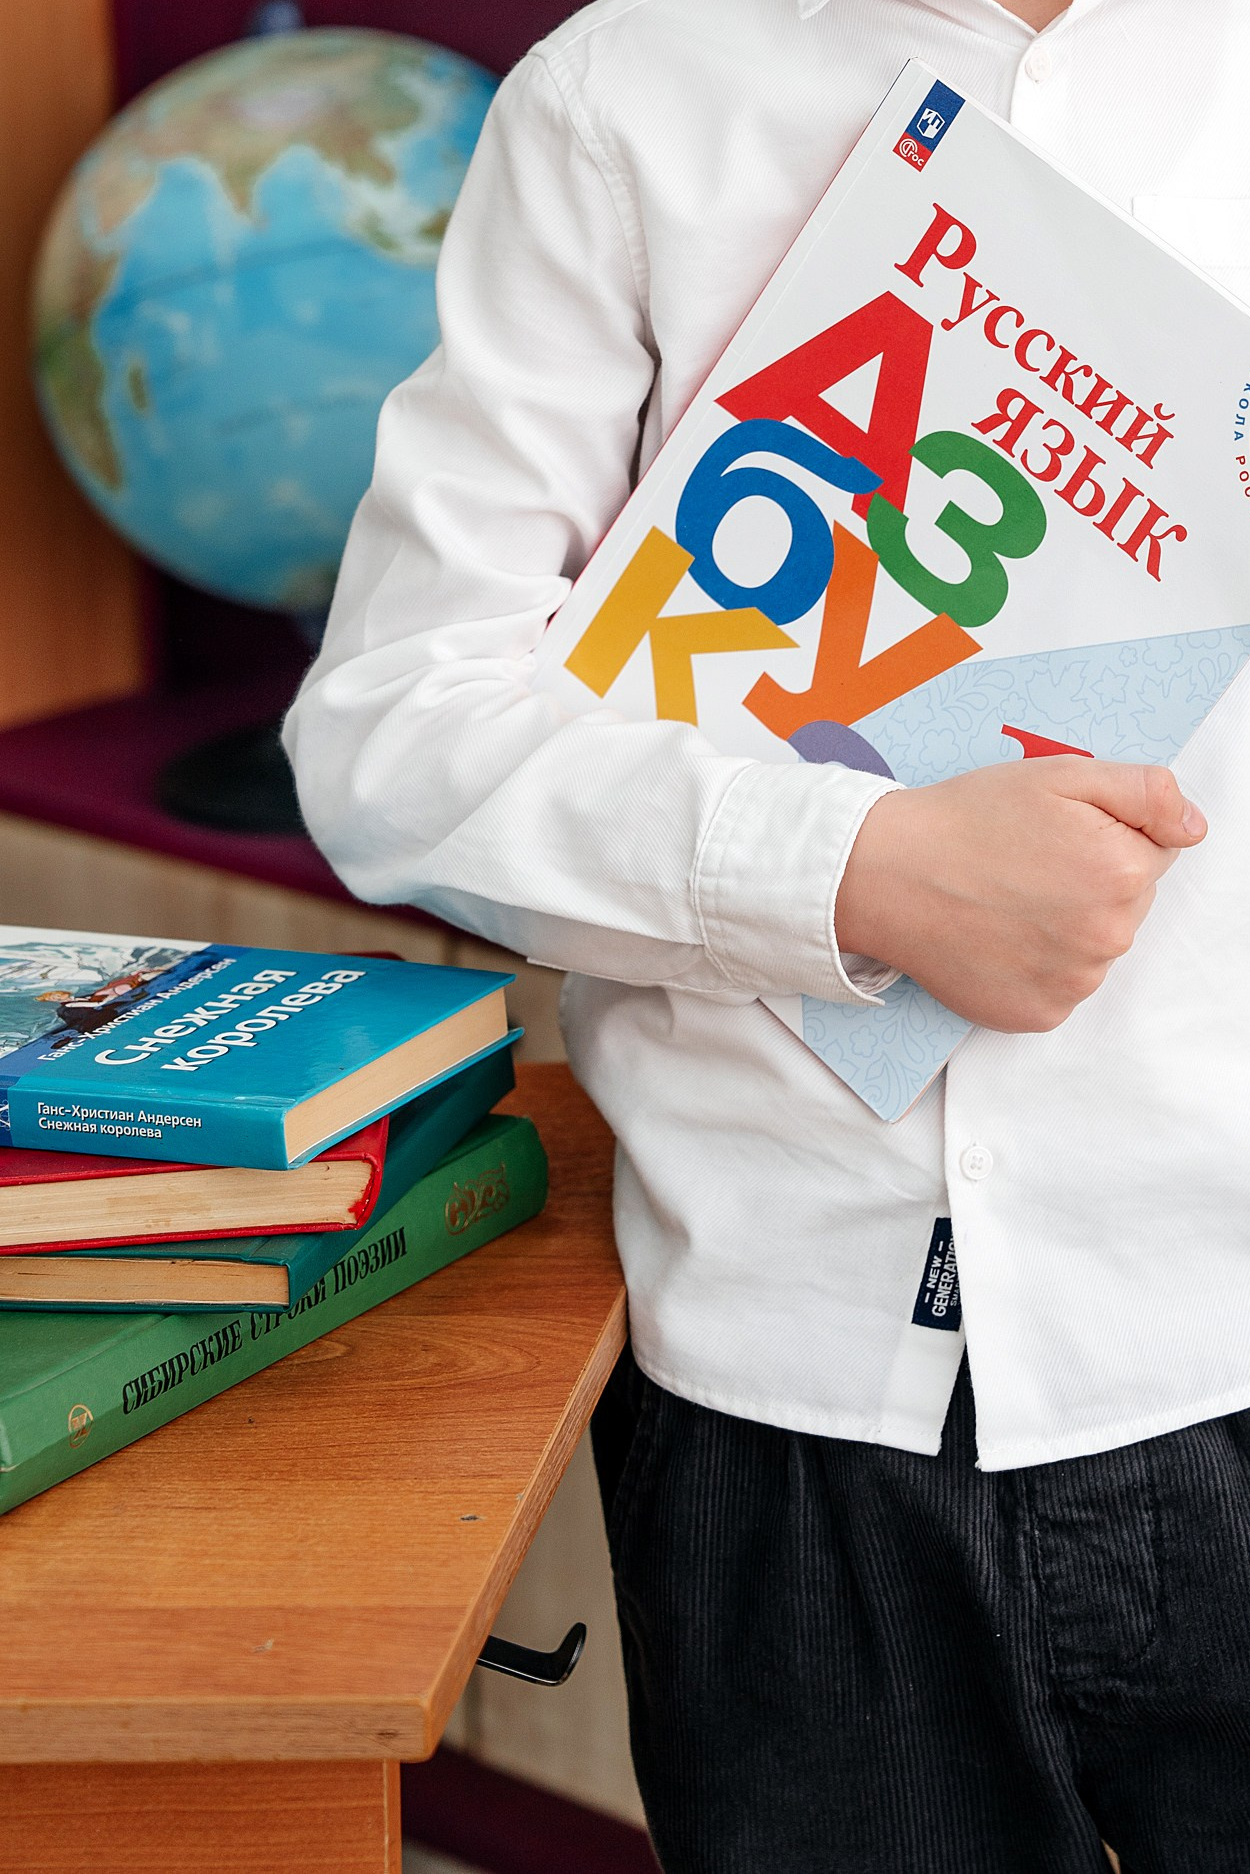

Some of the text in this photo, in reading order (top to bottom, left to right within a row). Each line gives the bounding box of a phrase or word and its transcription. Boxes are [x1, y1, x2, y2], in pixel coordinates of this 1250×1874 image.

[894, 202, 1176, 470] Русский
[37, 958, 238, 1062] Ганс-Христиан Андерсен
[94, 969, 298, 1066] Снежная
[160, 970, 367, 1072] королева
[37, 1101, 202, 1128] Ганс-Христиан Андерсен
[38, 1117, 162, 1140] Снежная королева
[122, 1319, 243, 1415] СИБИРСКИЕ
[333, 1226, 408, 1296] ПОЭЗИИ
[926, 1255, 942, 1289] NEW
